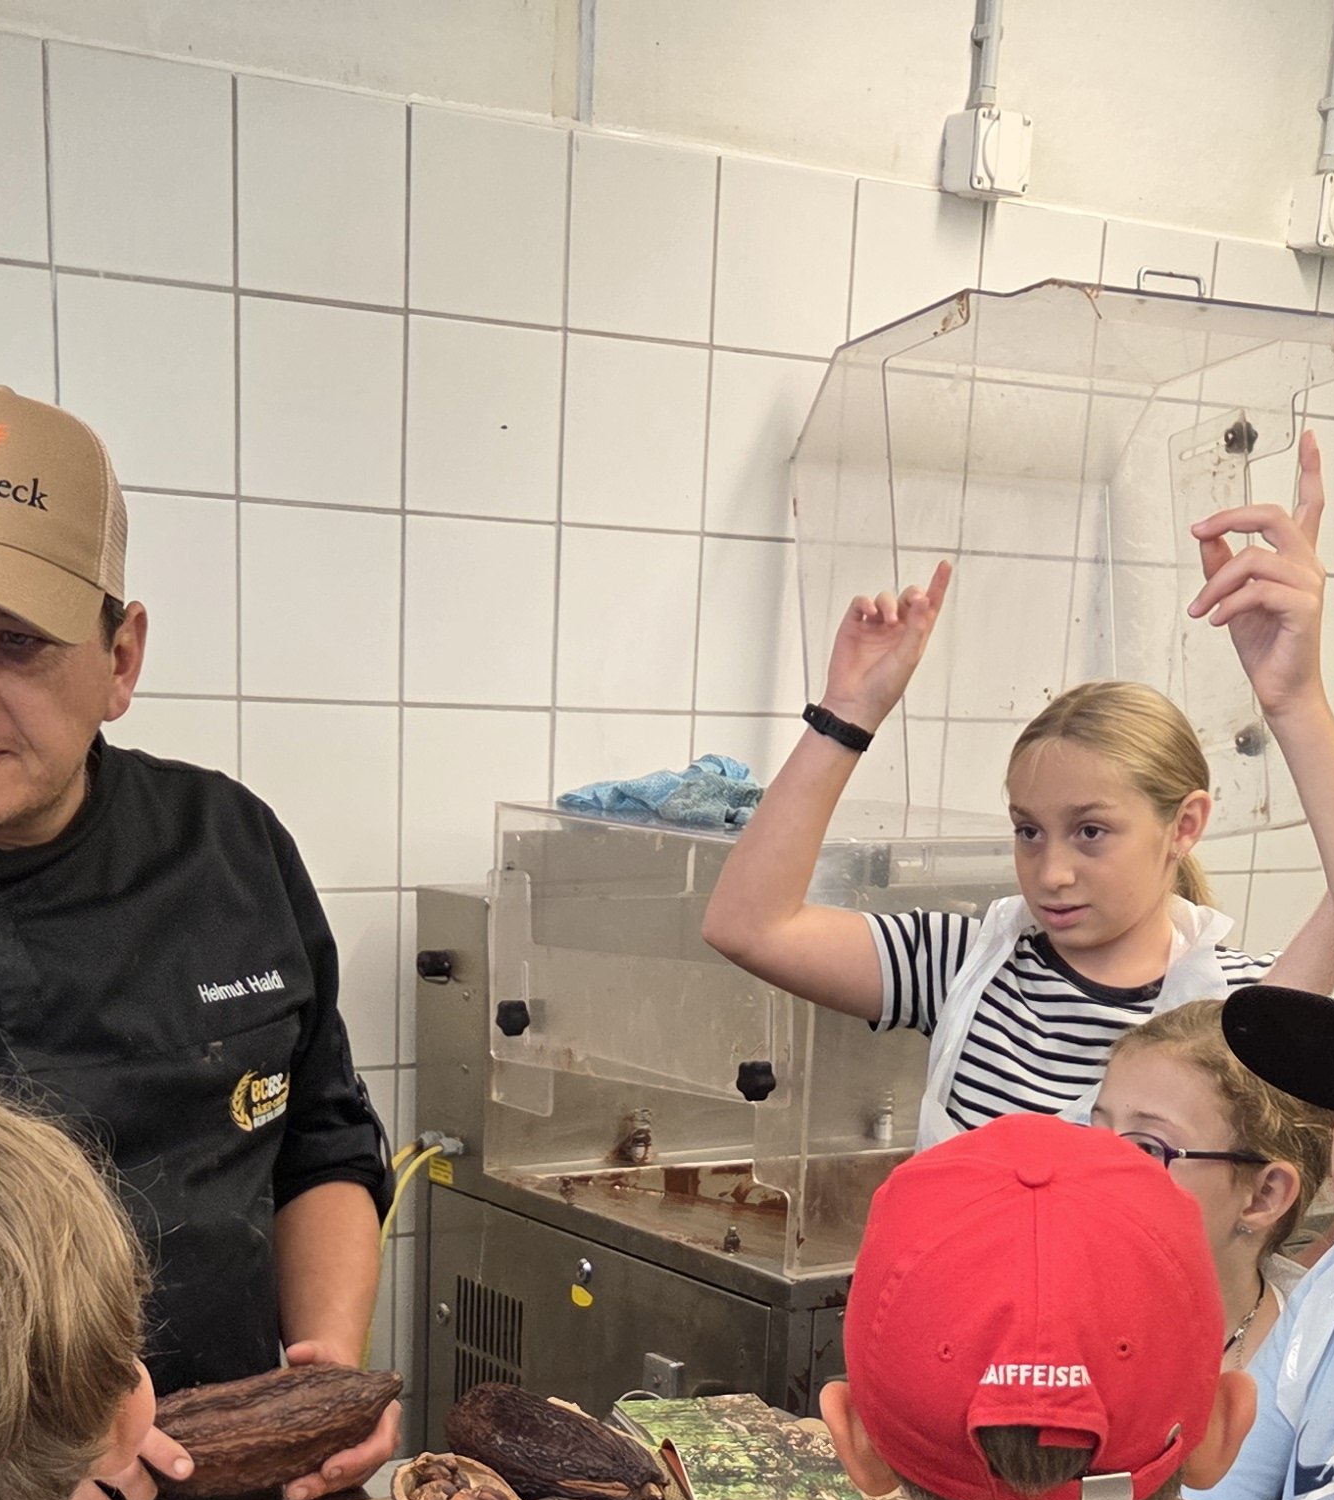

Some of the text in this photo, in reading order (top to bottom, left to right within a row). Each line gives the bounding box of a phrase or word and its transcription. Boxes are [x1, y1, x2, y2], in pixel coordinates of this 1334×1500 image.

[198, 969, 285, 1003] Helmut Haldi
[978, 1363, 1092, 1388] AIFFEISEN
